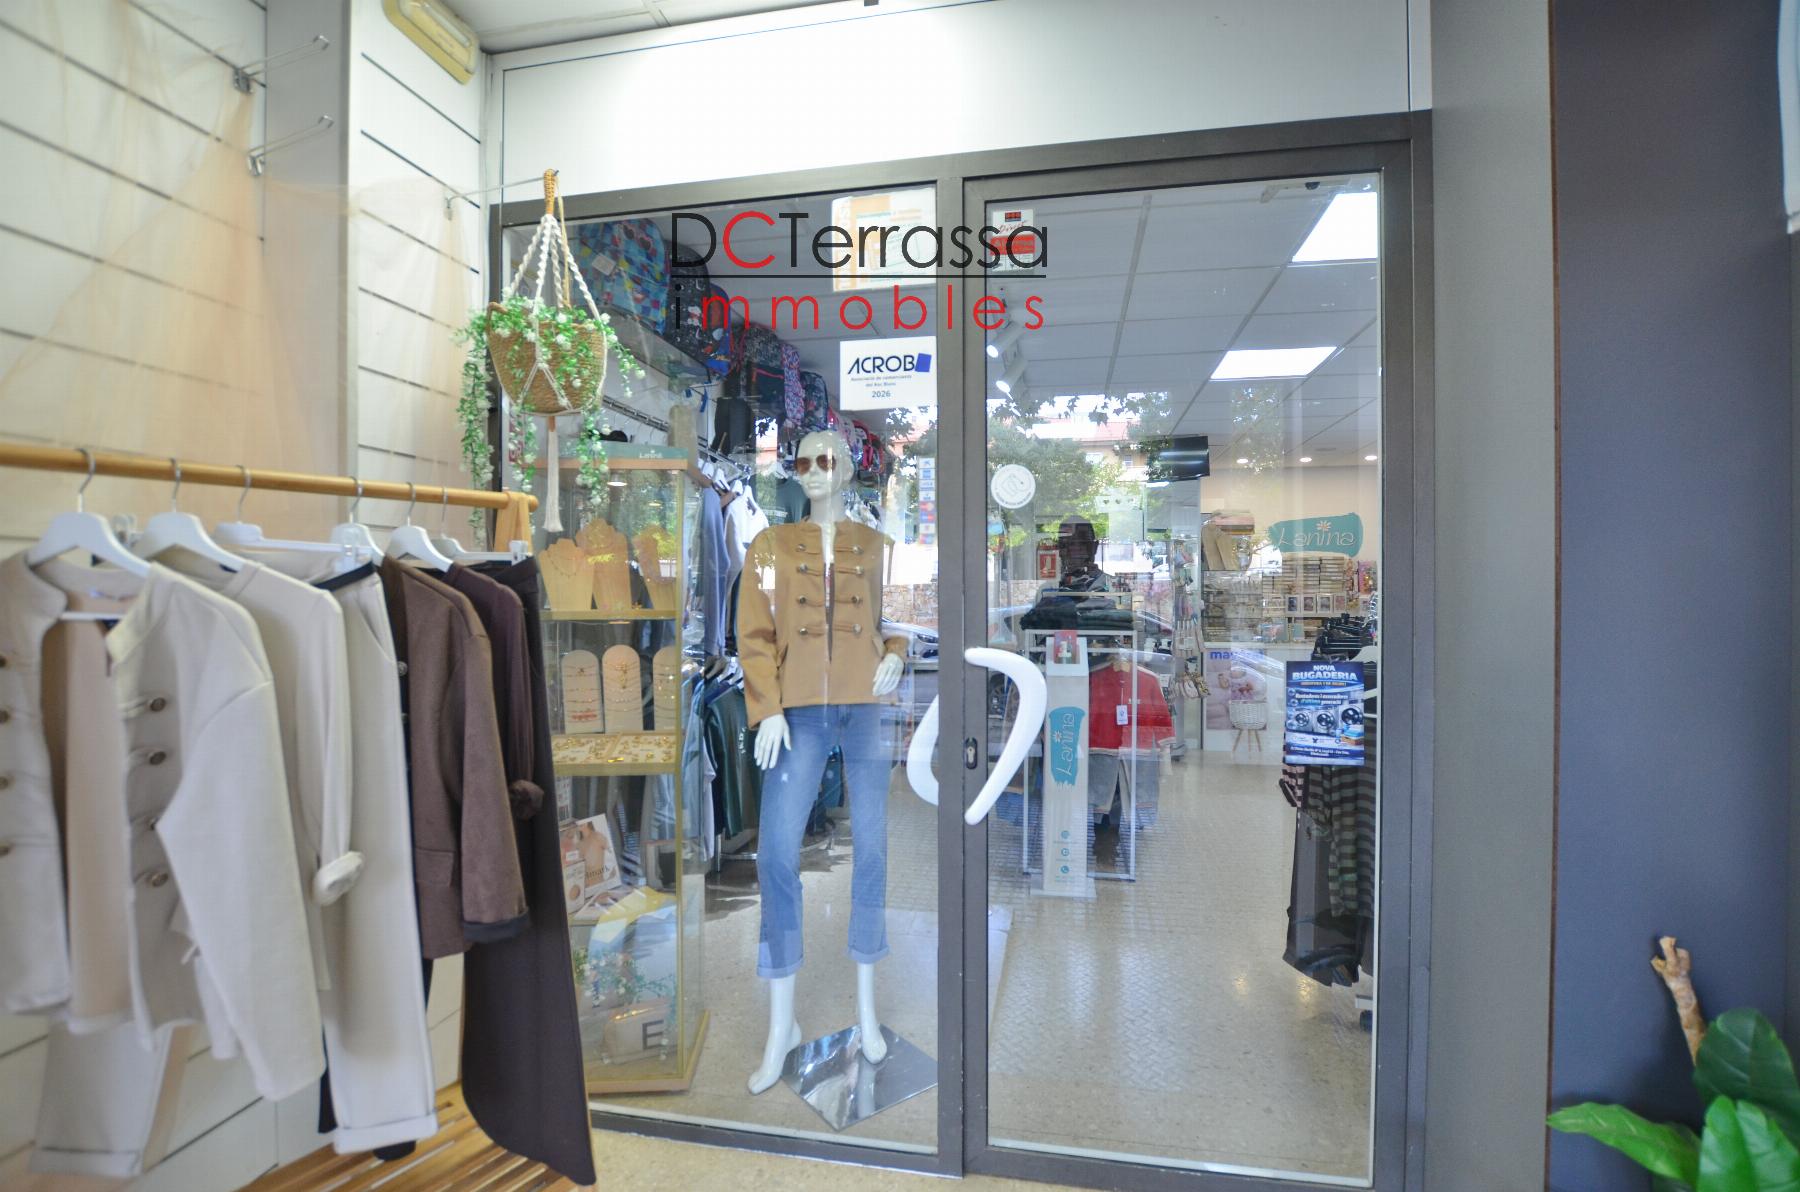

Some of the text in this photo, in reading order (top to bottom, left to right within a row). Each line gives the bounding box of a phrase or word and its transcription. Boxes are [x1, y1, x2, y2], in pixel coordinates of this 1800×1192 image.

[848, 354, 915, 374] ACROB
[871, 390, 891, 398] 2026
[1292, 671, 1358, 680] BUGADERIA
